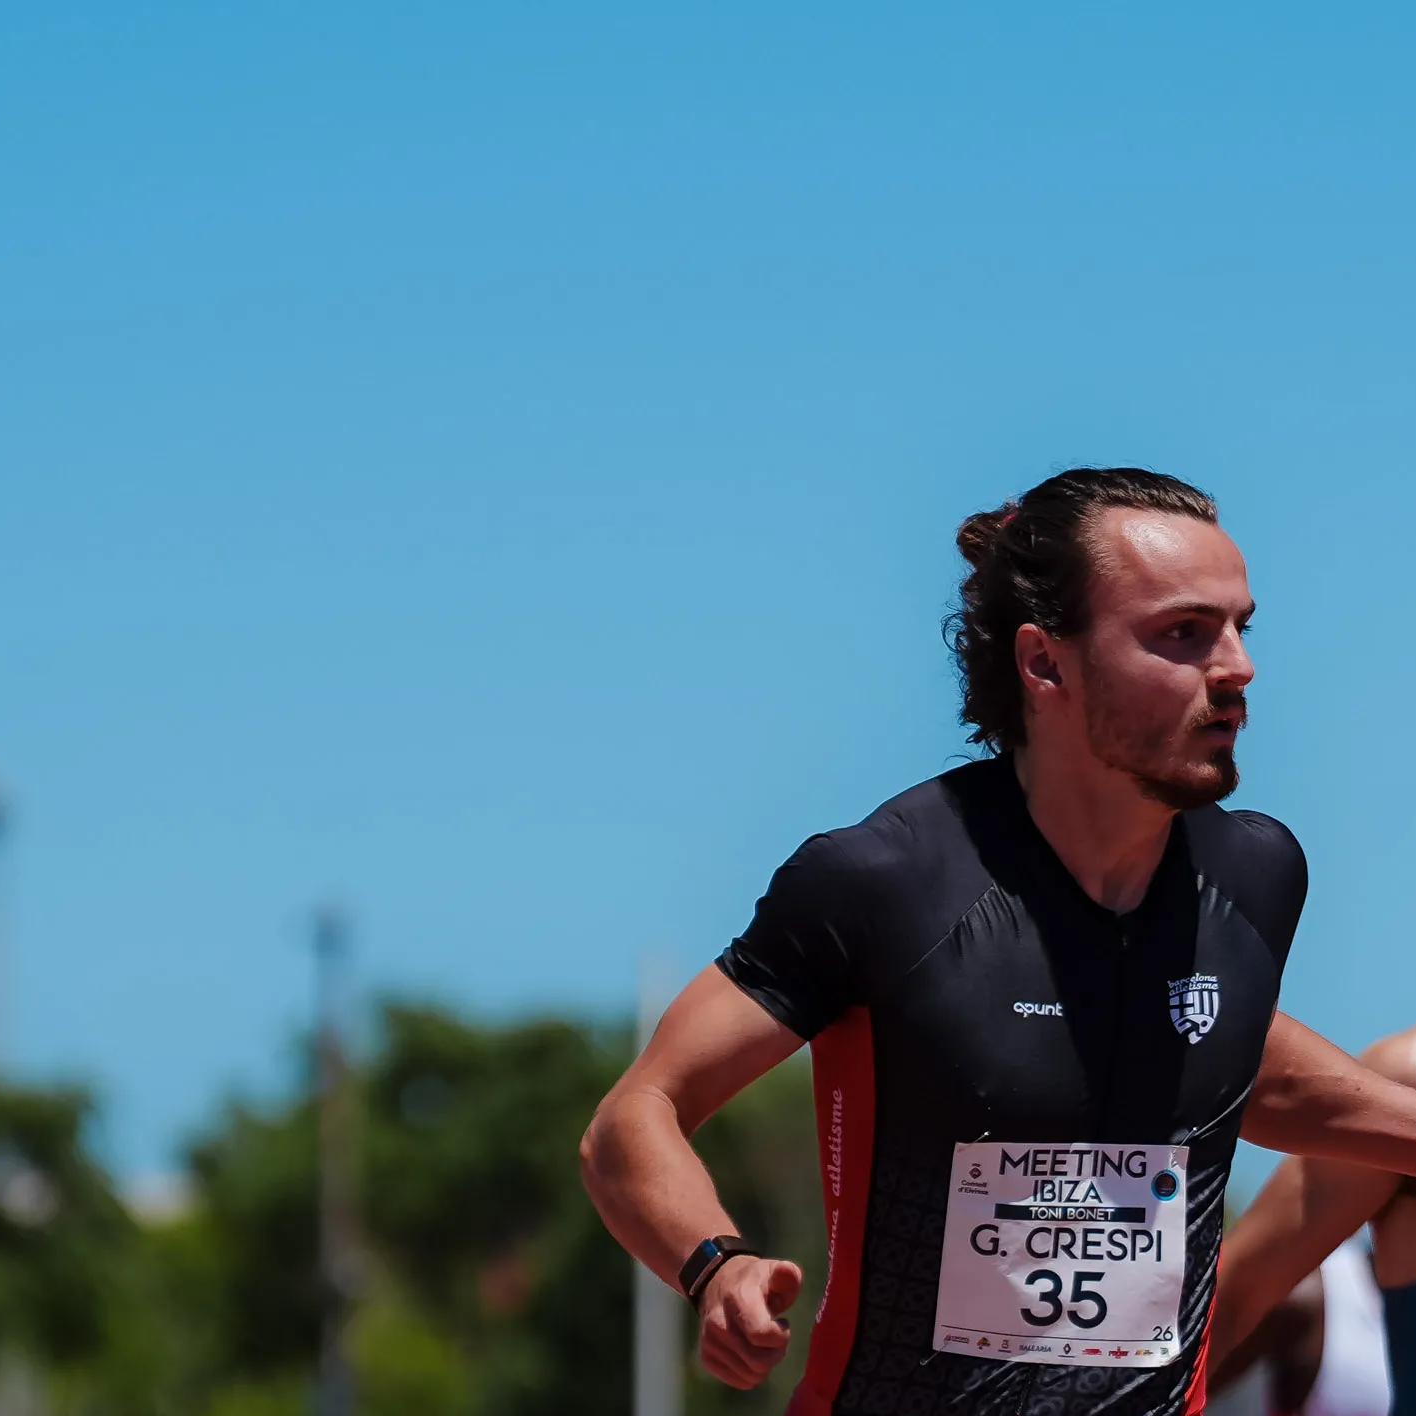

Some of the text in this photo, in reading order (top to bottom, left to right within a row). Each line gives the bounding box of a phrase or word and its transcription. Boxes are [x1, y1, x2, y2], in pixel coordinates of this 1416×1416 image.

[1167, 972, 1218, 989] barcelona
[1169, 981, 1219, 996] atletisme
[827, 1086, 844, 1197] atletisme
[999, 1148, 1147, 1178] MEETING
[1033, 1180, 1103, 1204] IBIZA
[1029, 1207, 1115, 1221] TONI BONET
[969, 1223, 1163, 1262] G. CRESPI
[1020, 1269, 1108, 1329] 35
[1152, 1326, 1174, 1342] 26
